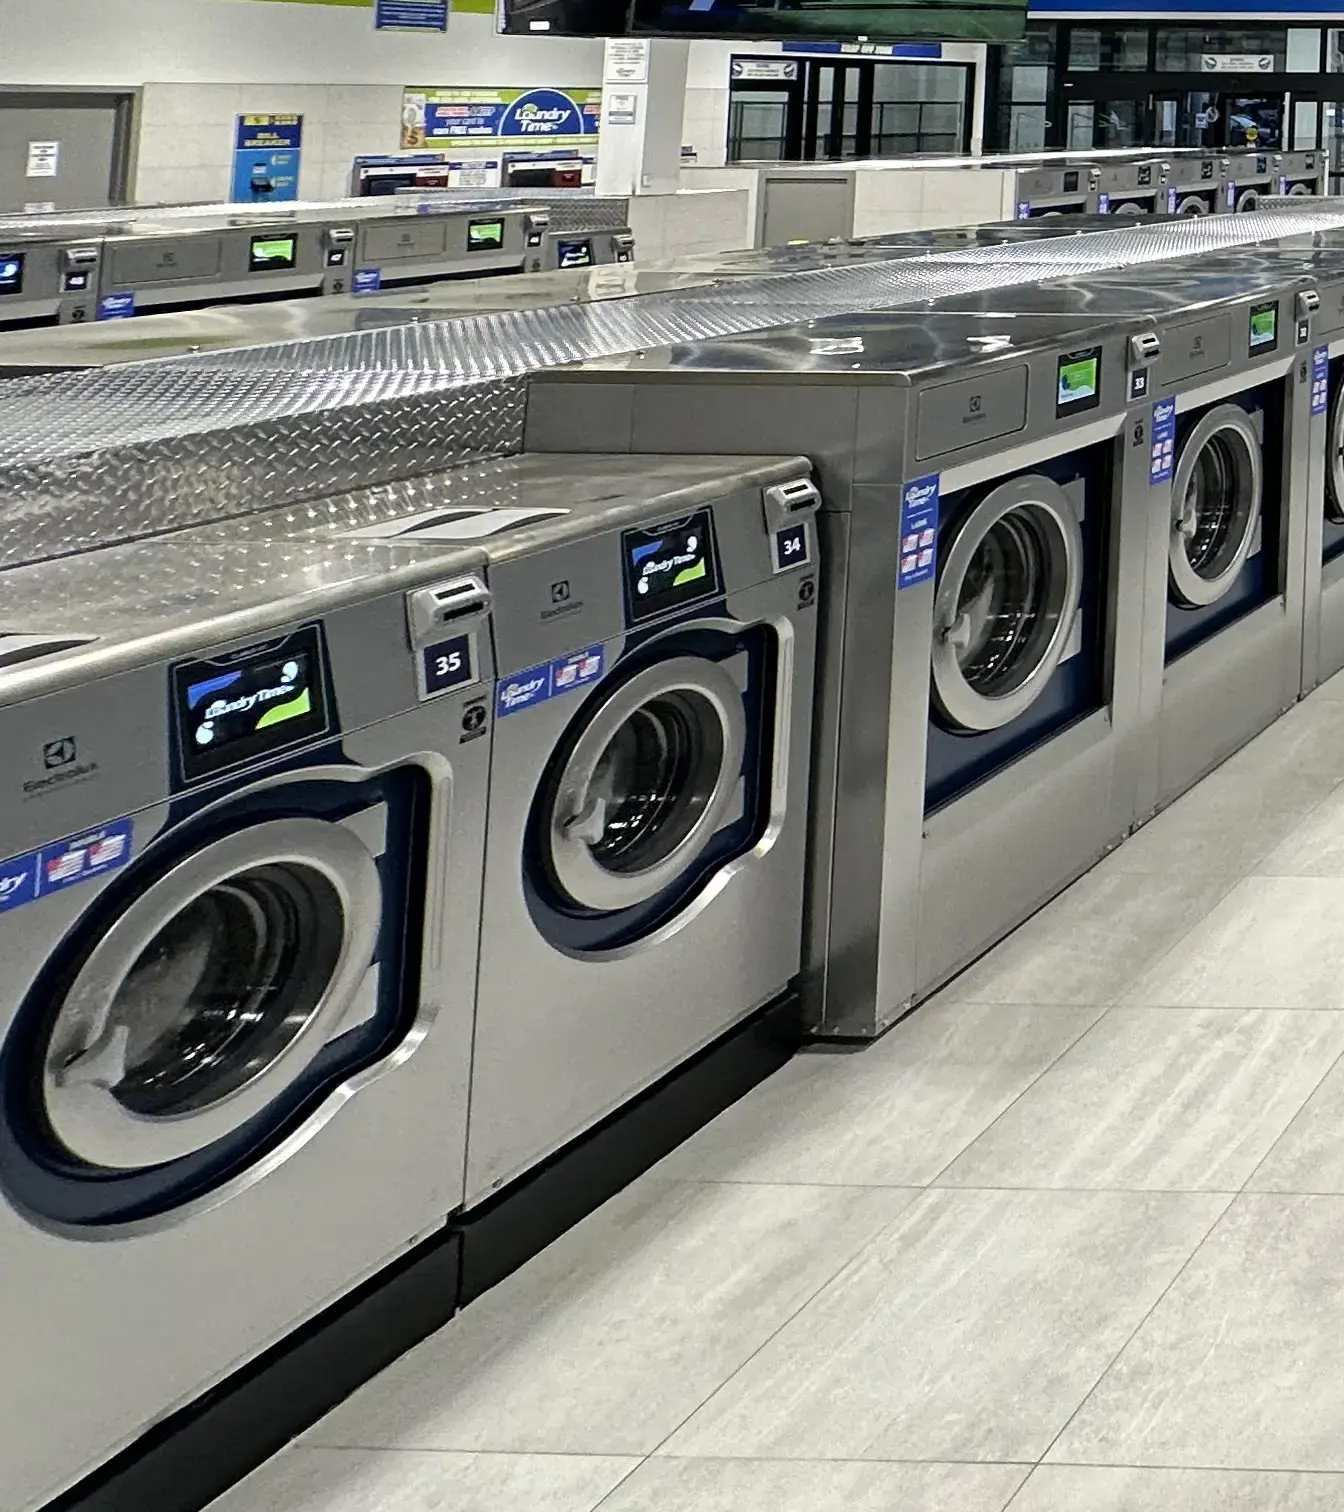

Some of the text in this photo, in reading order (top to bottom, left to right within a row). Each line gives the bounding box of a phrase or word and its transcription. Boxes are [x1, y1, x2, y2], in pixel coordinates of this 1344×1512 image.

[520, 119, 557, 132] Time
[1134, 377, 1145, 390] 33
[783, 537, 801, 556] 34
[435, 651, 461, 676] 35
[501, 677, 545, 701] Laundry
[504, 691, 536, 709] Time
